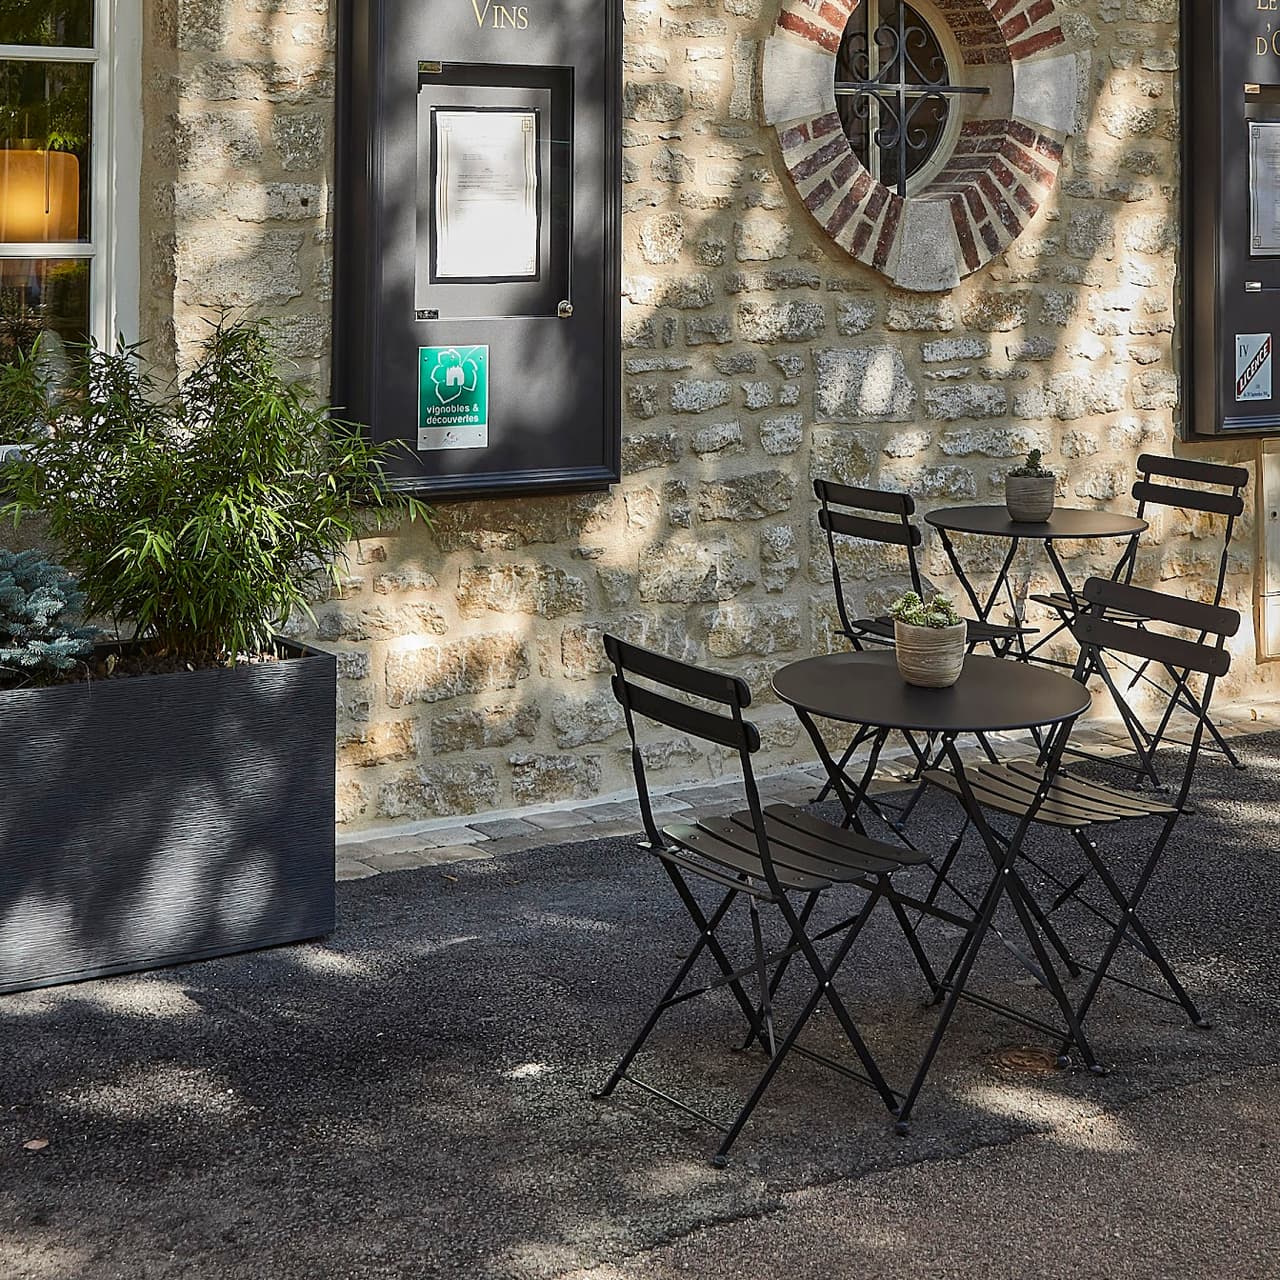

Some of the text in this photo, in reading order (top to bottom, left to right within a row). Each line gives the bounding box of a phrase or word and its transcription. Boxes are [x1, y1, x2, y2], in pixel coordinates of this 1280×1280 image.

[1239, 344, 1250, 358] IV
[1239, 342, 1269, 392] LICENCE
[426, 403, 479, 416] vignobles &
[426, 414, 479, 425] découvertes
